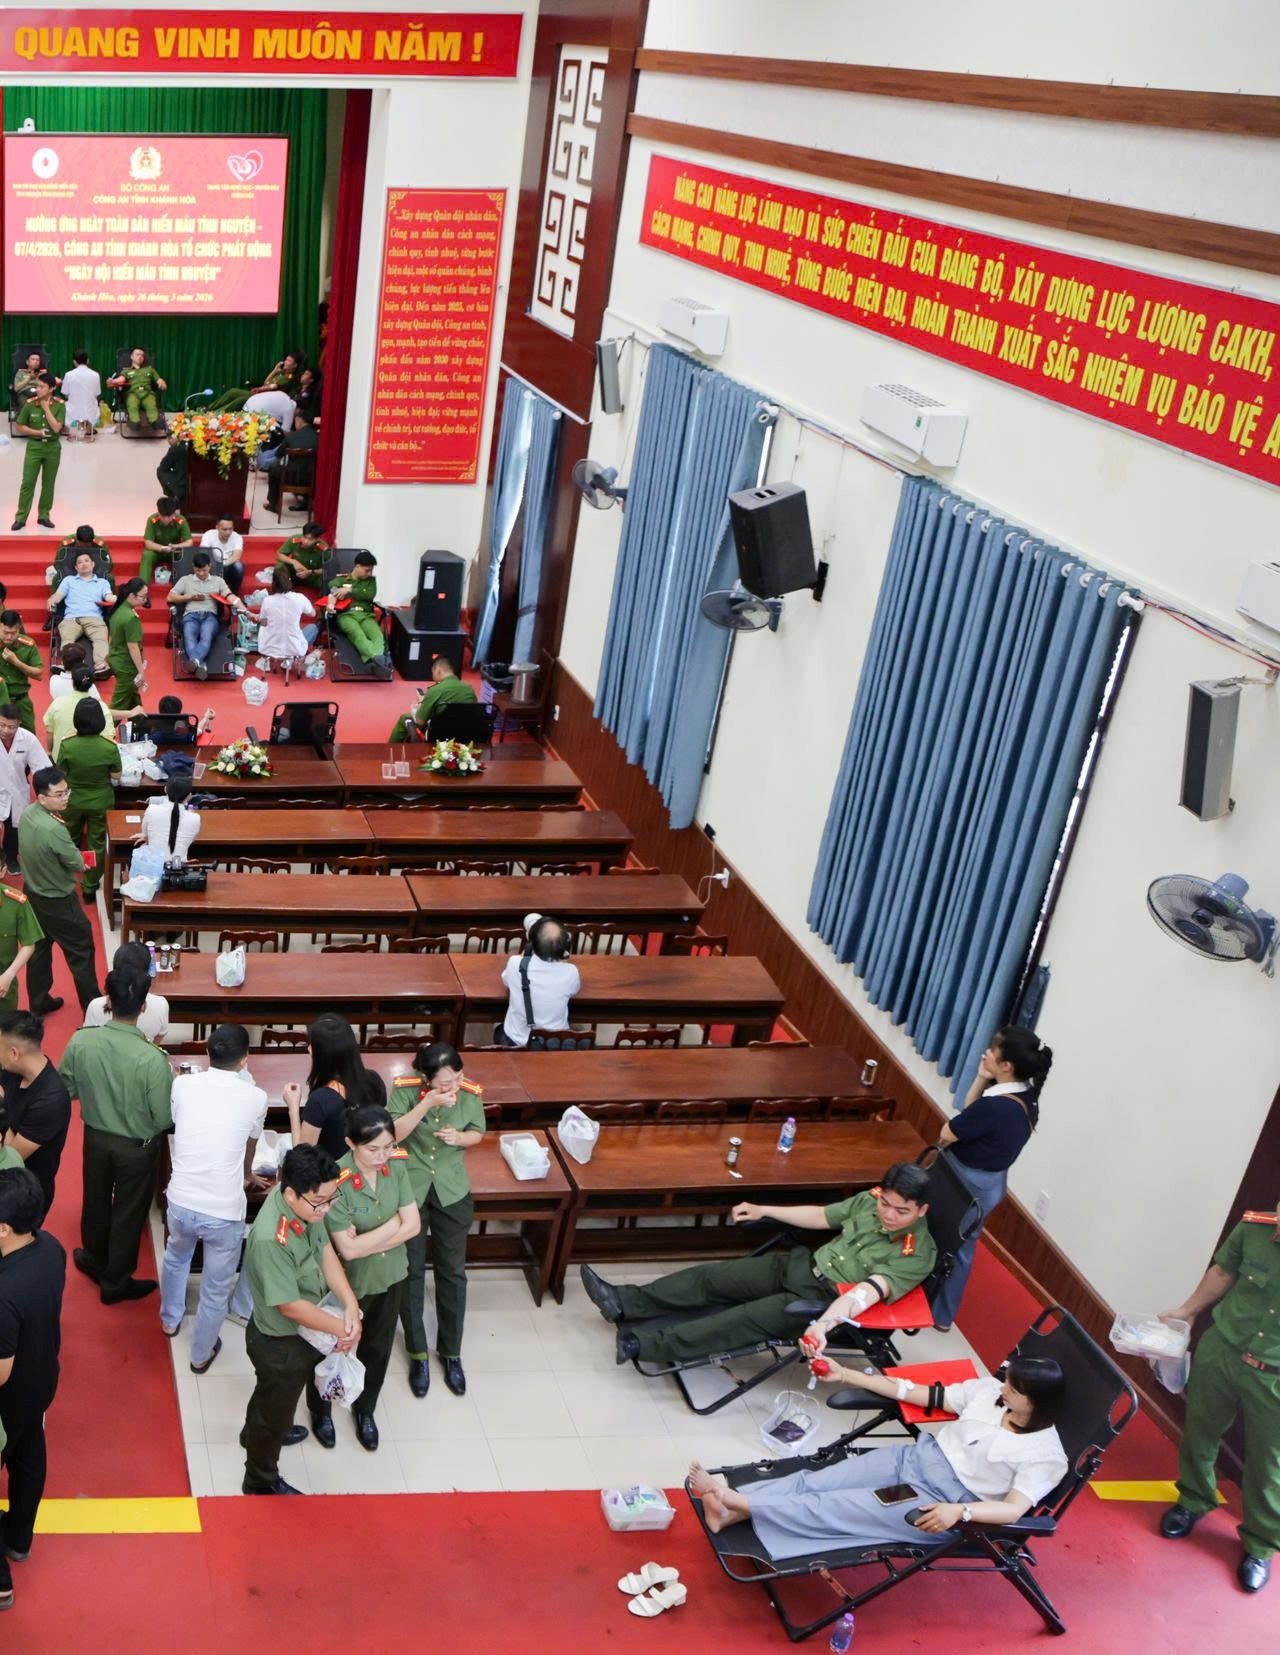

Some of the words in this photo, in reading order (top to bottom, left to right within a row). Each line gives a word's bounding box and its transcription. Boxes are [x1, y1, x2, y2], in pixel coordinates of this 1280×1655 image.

[15, 27, 139, 60] QUANG
[154, 28, 240, 58] VINH
[253, 21, 362, 59] MUÔN
[373, 22, 462, 61] NĂM
[471, 32, 484, 62] !
[821, 208, 845, 250] SỨC
[845, 210, 883, 260] CHIẾN
[881, 218, 910, 269] ĐẤU
[909, 229, 938, 277] CỦA
[938, 237, 980, 290] ĐẢNG
[979, 252, 1005, 304] BỘ,
[1008, 261, 1045, 308] XÂY
[1044, 275, 1095, 325] DỰNG
[1095, 289, 1136, 340] LỰC
[1135, 300, 1207, 356] LƯỢNG
[1208, 318, 1276, 383] CAKH,
[822, 262, 853, 303] BƯỚC
[853, 273, 884, 317] HIỆN
[882, 286, 907, 328] ĐẠI,
[910, 291, 950, 338] HOÀN
[950, 304, 999, 355] THÀNH
[998, 314, 1043, 370] XUẤT
[1041, 326, 1079, 384] SẮC
[1080, 353, 1145, 409] NHIỆM
[1146, 372, 1177, 426] VỤ
[1177, 373, 1226, 436] BẢO
[1228, 395, 1264, 457] VỆ
